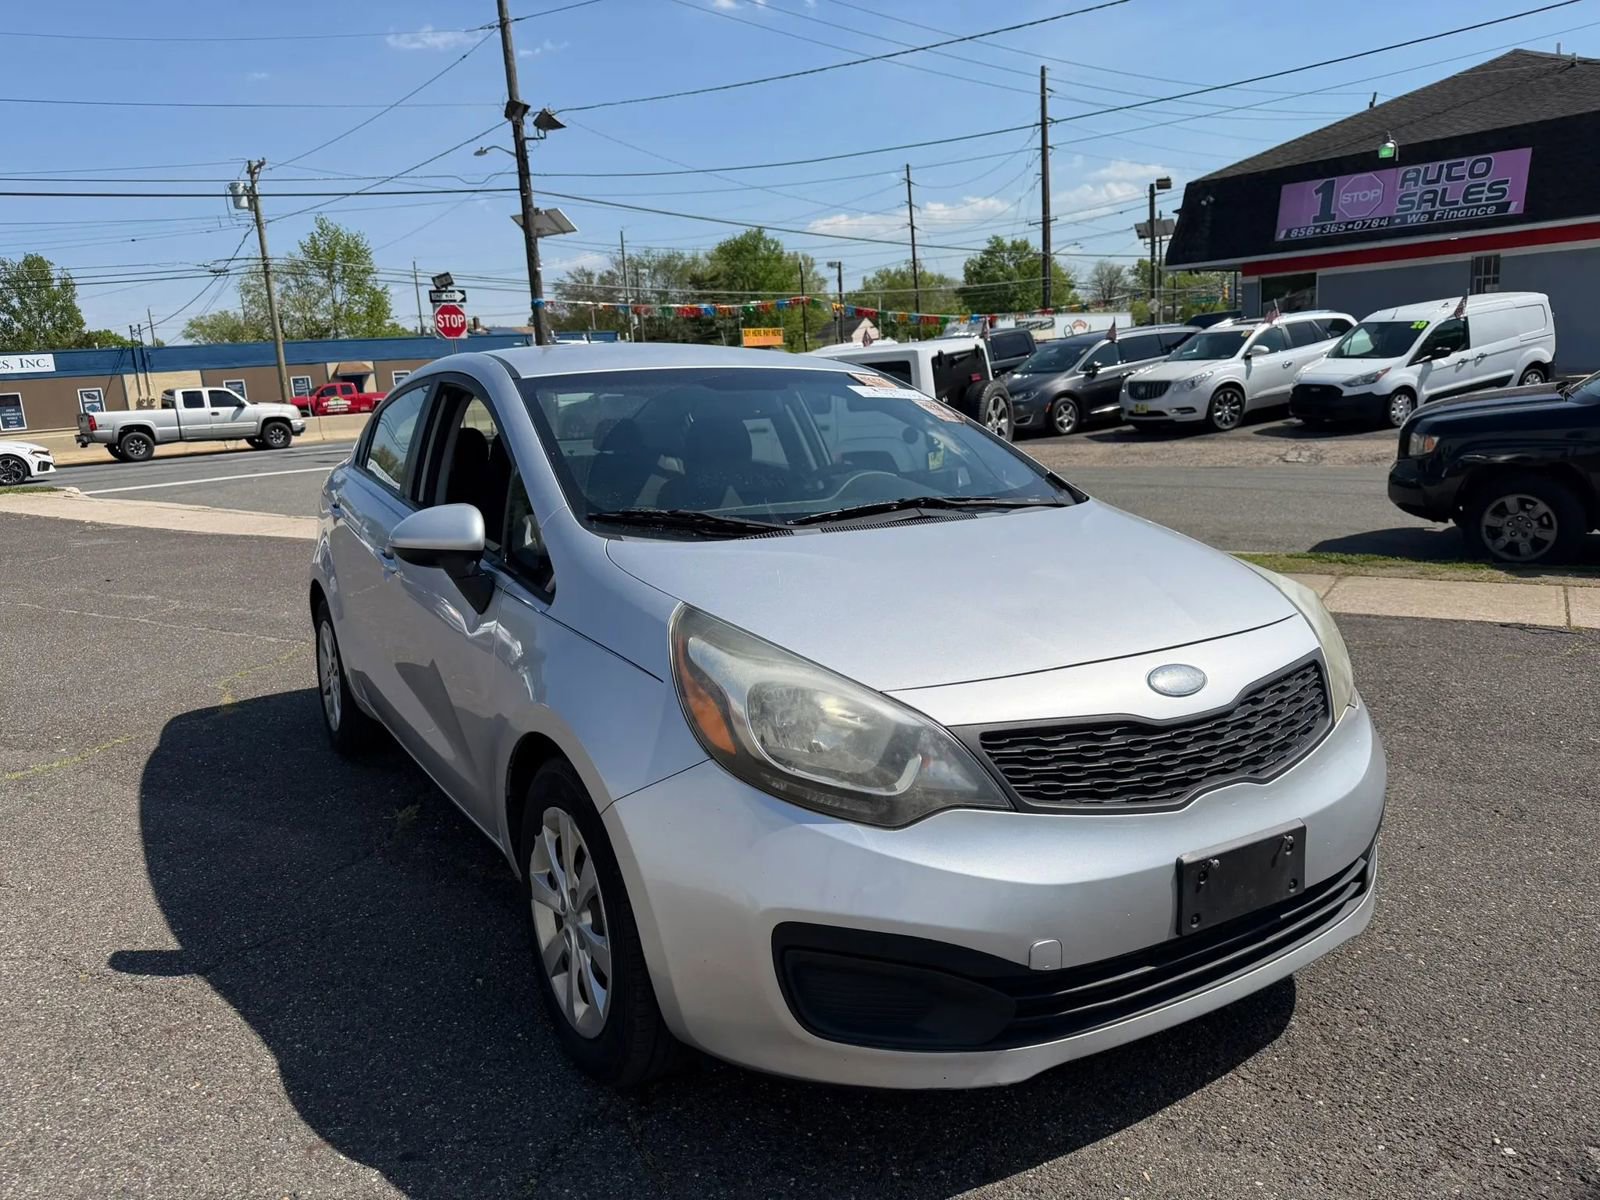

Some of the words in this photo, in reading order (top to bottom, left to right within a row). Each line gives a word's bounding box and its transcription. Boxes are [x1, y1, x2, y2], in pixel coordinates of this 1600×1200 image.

[1398, 155, 1494, 191] AUTO
[1312, 178, 1337, 224] 1
[1341, 189, 1380, 204] STOP
[1395, 178, 1510, 214] SALES
[1407, 213, 1429, 224] We
[1434, 204, 1497, 221] Finance
[437, 314, 465, 328] STOP
